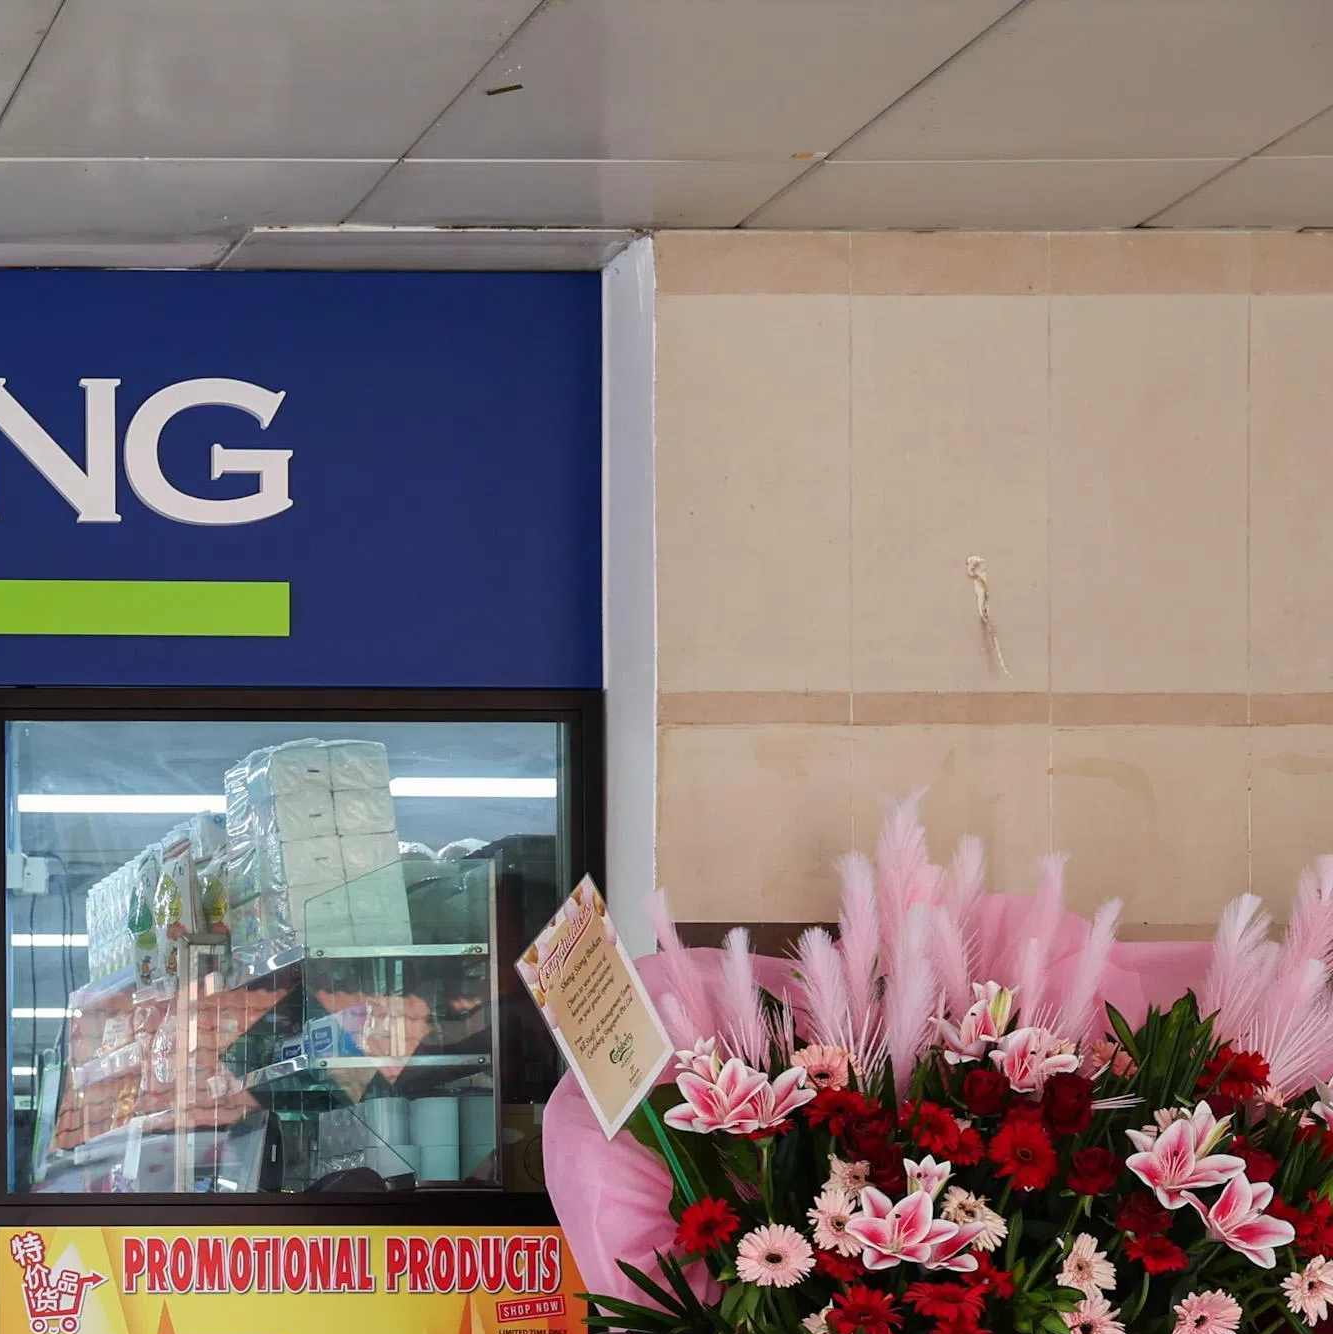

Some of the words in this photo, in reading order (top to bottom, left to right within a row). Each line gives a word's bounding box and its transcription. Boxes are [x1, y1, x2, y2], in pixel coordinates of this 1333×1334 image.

[609, 1032, 633, 1064] Carlsberg
[123, 1236, 376, 1294] PROMOTIONAL
[385, 1235, 562, 1294] PRODUCTS
[504, 1304, 531, 1317] SHOP
[536, 1302, 559, 1313] NOW
